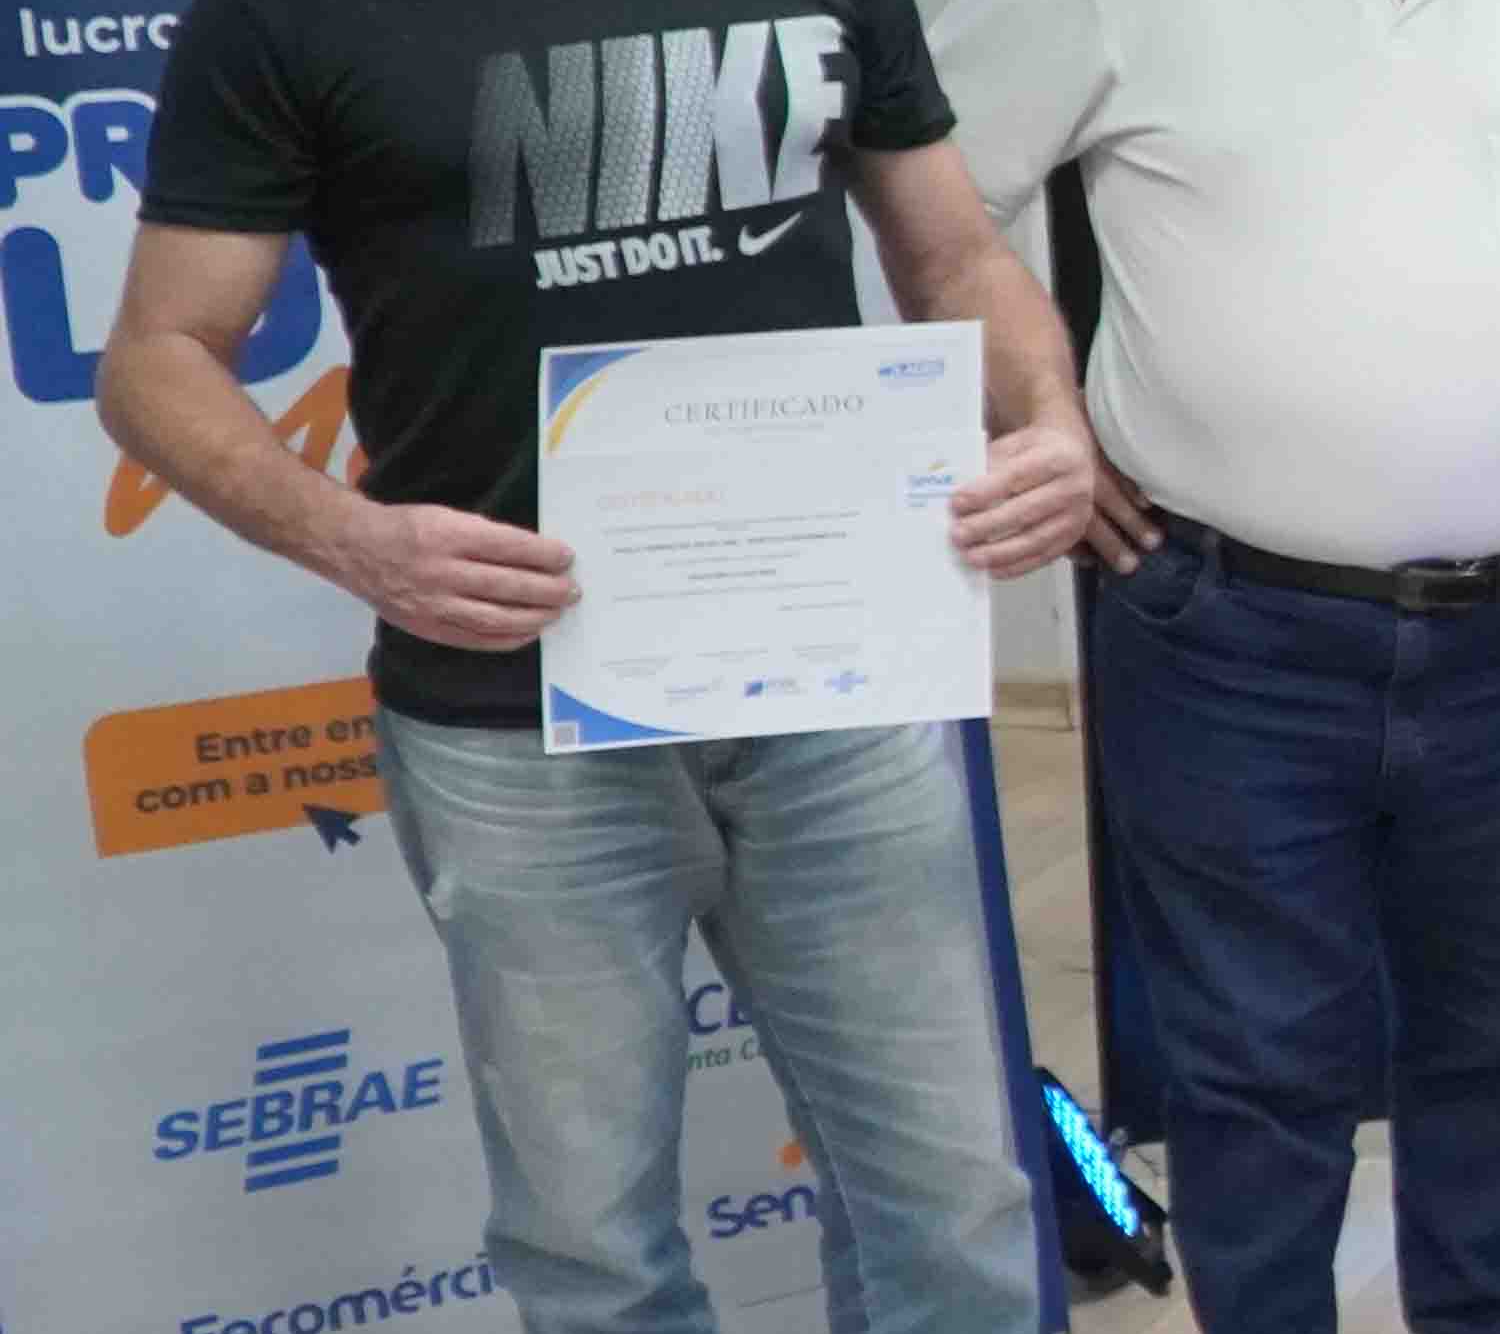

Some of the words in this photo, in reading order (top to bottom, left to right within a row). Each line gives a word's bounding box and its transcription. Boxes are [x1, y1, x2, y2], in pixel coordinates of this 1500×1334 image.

[465, 14, 851, 248] NIKE
[535, 242, 618, 290] JUST
[626, 236, 676, 281] DO
[681, 226, 724, 266] IT.
[664, 393, 865, 426] CERTIFICADO
[194, 723, 312, 765] Entre
[135, 776, 232, 815] com
[245, 771, 270, 797] a
[284, 752, 379, 790] noss
[153, 1057, 444, 1162] SEBRAE
[706, 1183, 818, 1240] Sen
